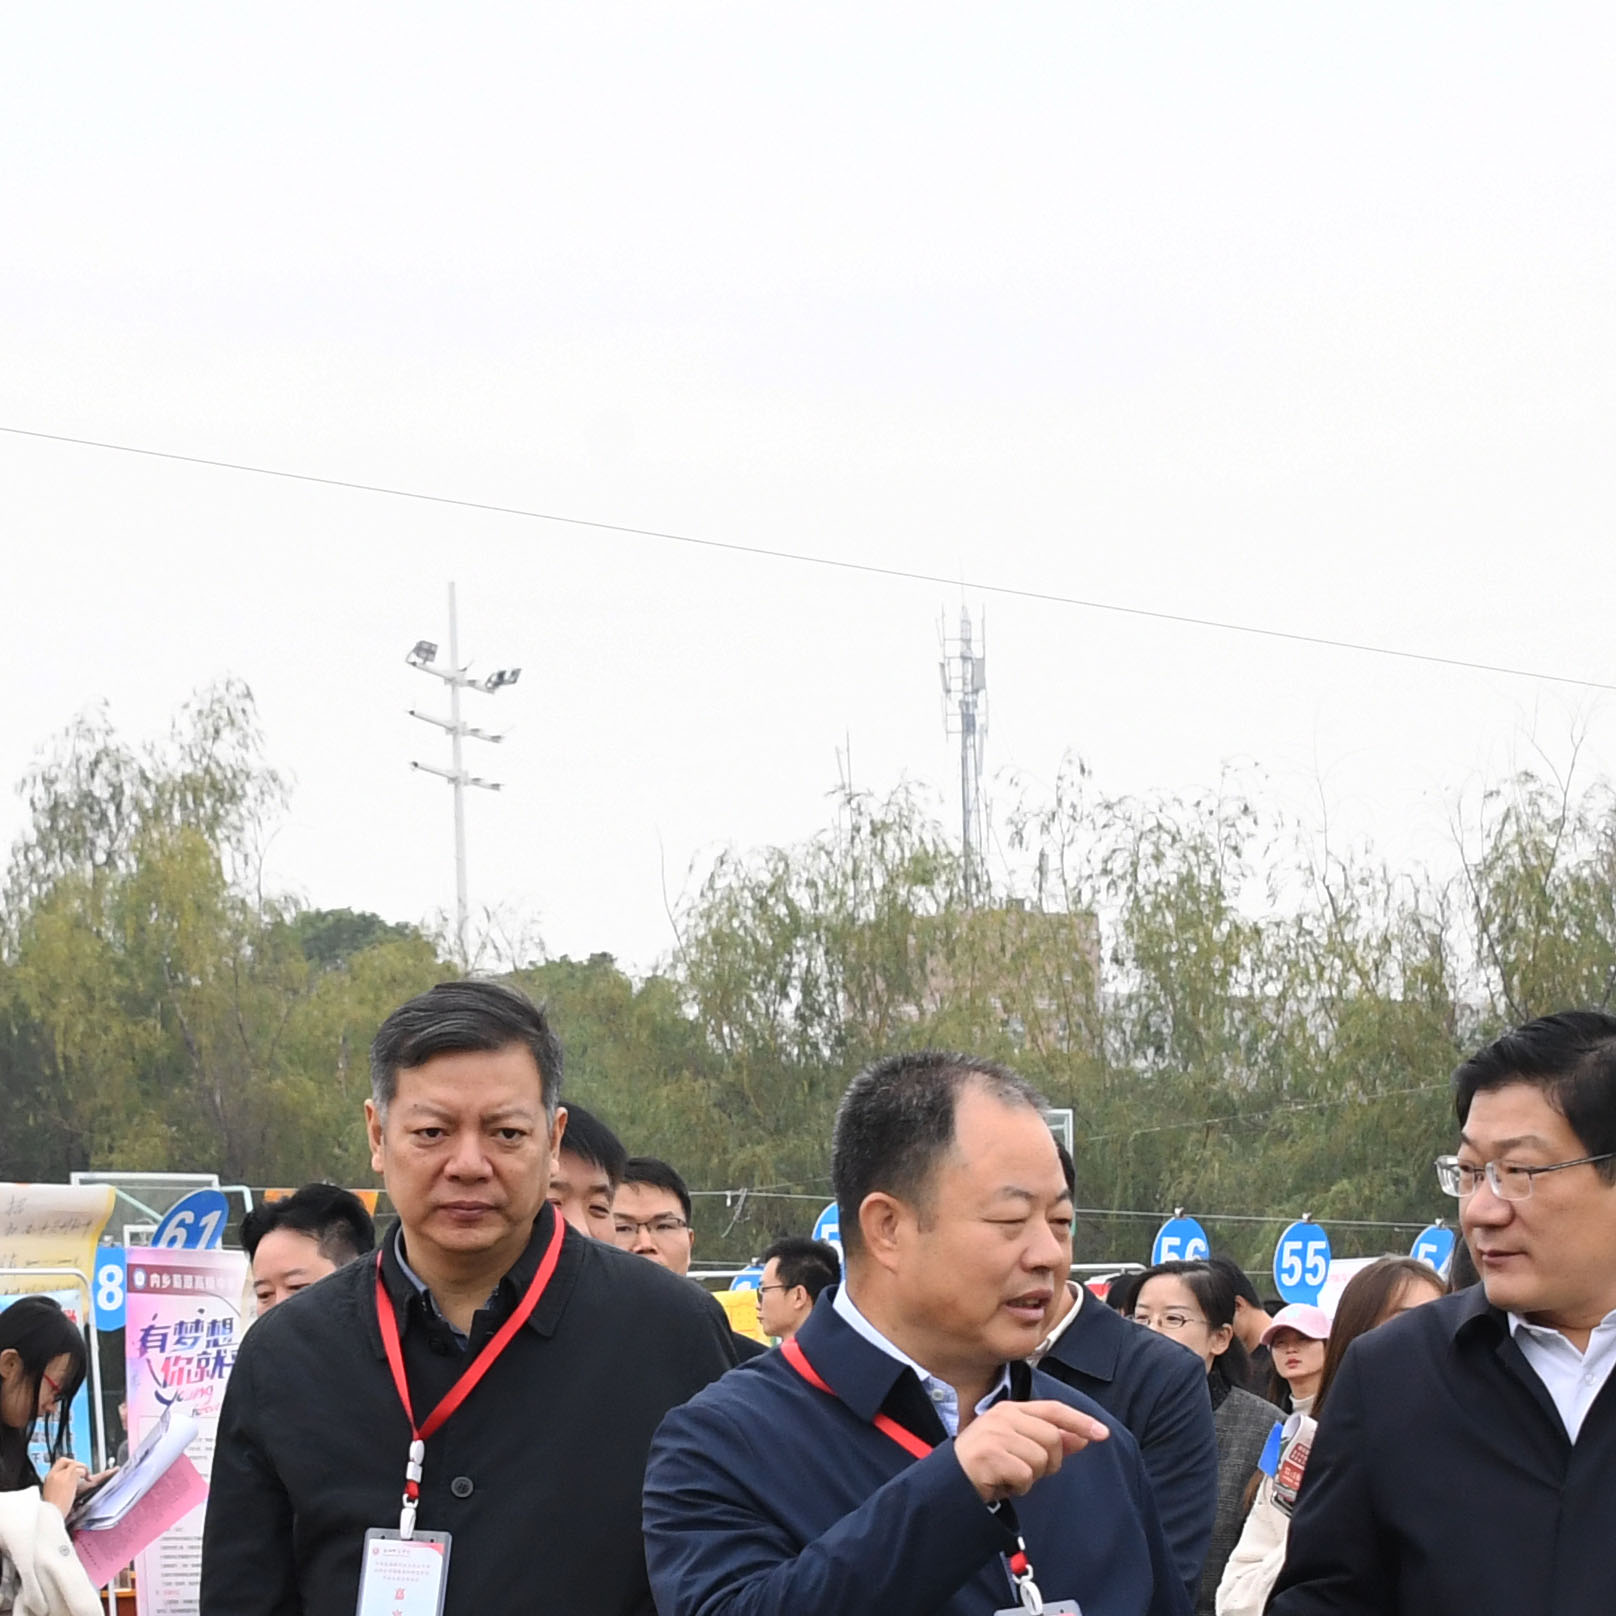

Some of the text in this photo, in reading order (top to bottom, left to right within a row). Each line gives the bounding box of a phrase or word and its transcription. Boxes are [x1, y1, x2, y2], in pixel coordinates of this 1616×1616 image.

[159, 1210, 223, 1250] 61
[1281, 1241, 1327, 1287] 55
[96, 1264, 124, 1311] 8
[139, 1308, 240, 1358] 有梦想
